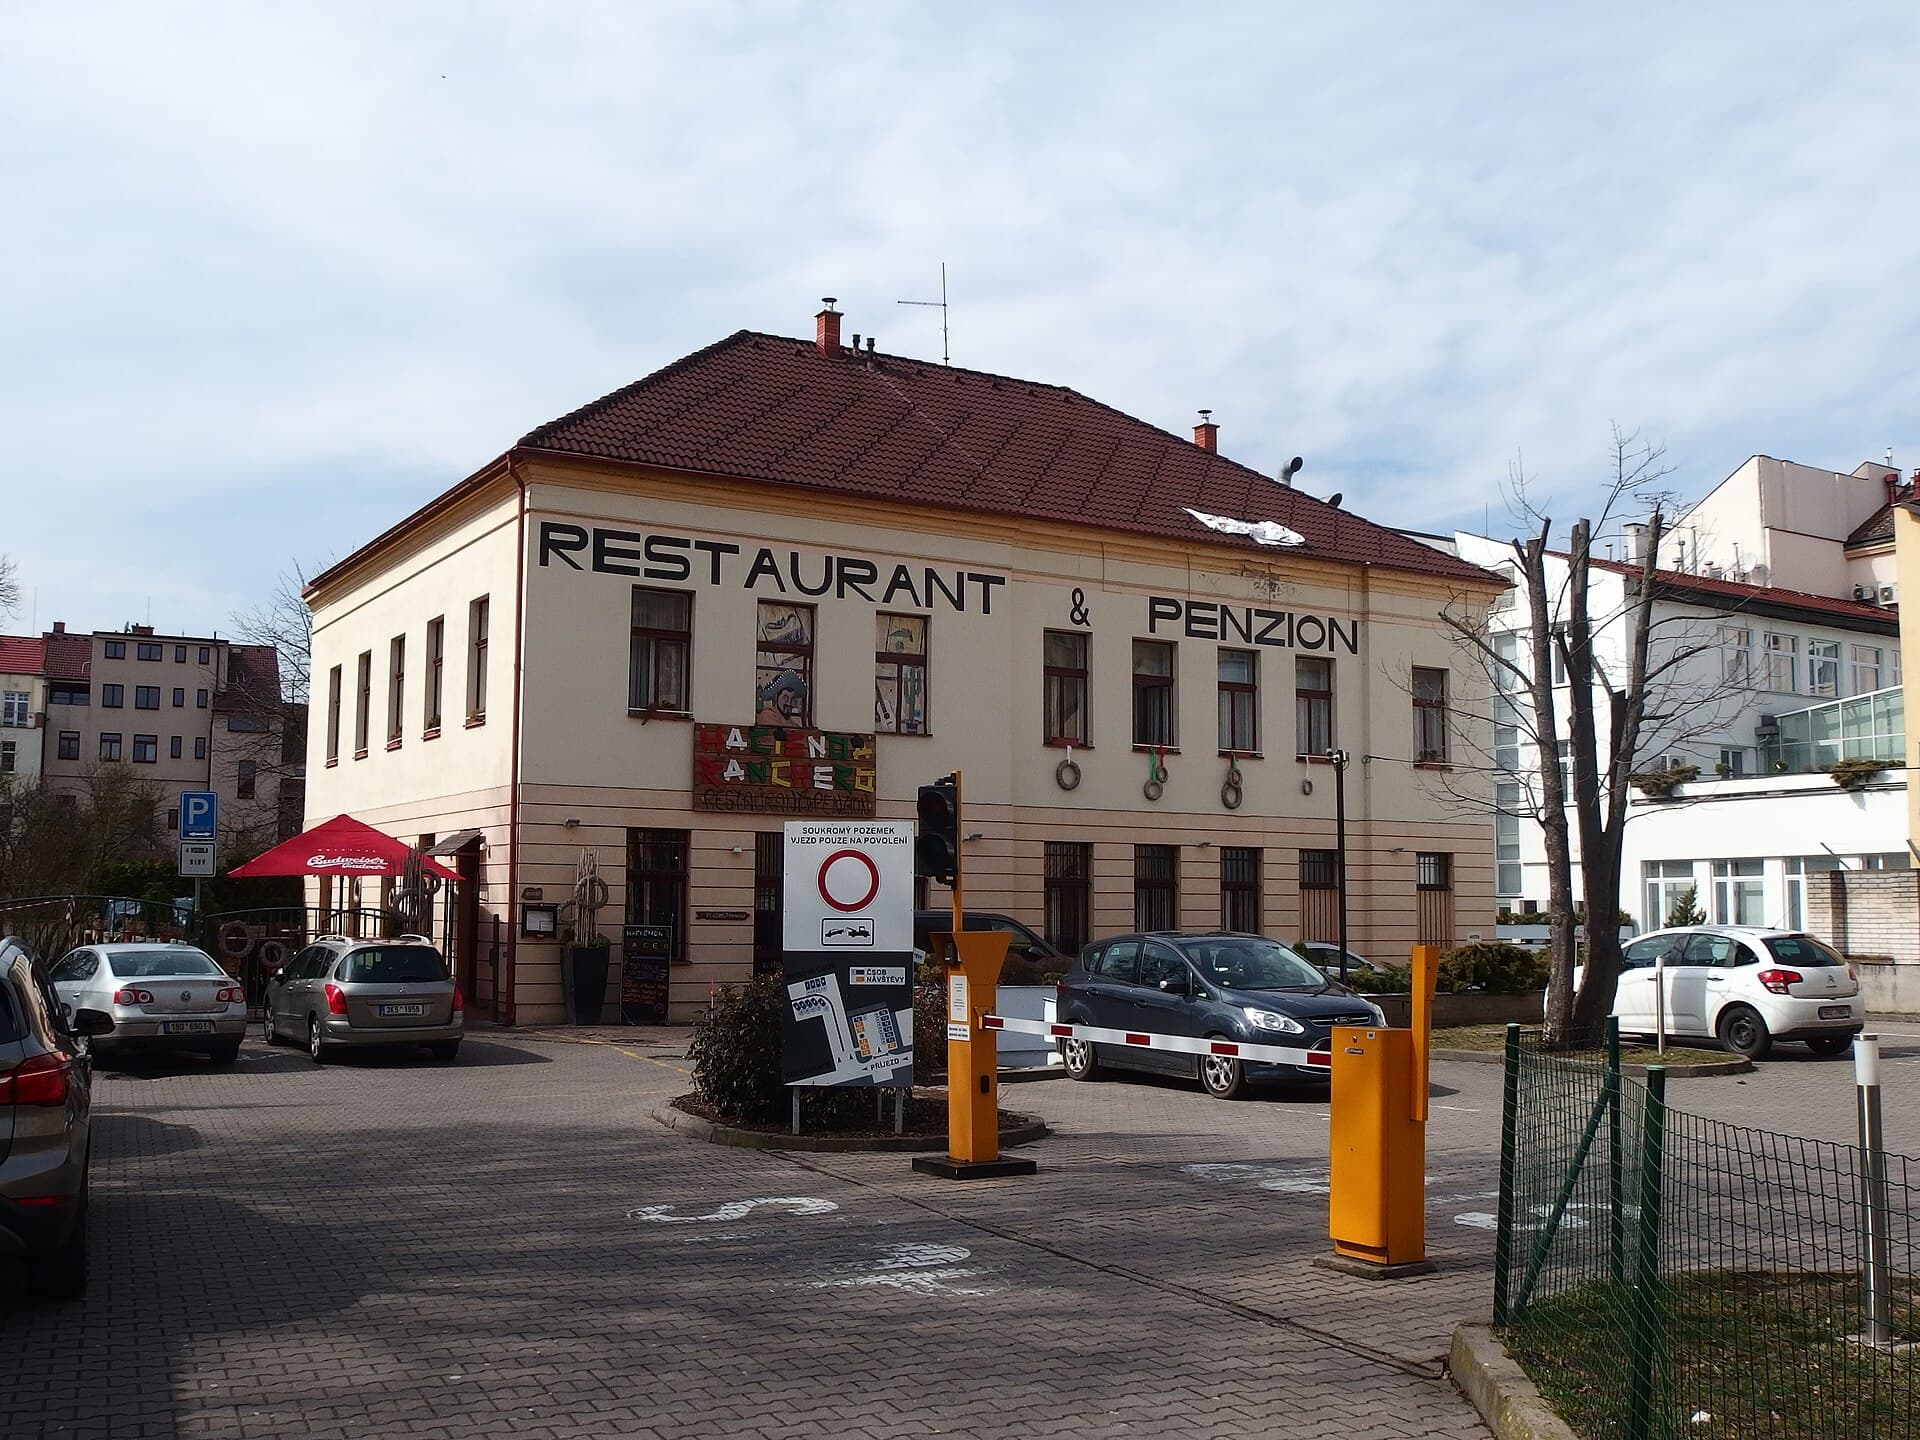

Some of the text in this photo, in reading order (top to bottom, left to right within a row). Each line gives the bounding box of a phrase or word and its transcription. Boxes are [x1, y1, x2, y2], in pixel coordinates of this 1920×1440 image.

[539, 520, 1358, 655] RESTAURANT & PENZION
[699, 727, 874, 760] HACIENDA
[697, 757, 876, 793] RANCHERO
[188, 798, 209, 825] P
[802, 826, 895, 835] SOUKROMÝ POZEMEK
[790, 835, 908, 845] VJEZD POUZE NA POVOLENÍ
[306, 854, 388, 868] Budweiser
[866, 968, 887, 976] ČSOB
[870, 1057, 900, 1071] PŘÍJEZD
